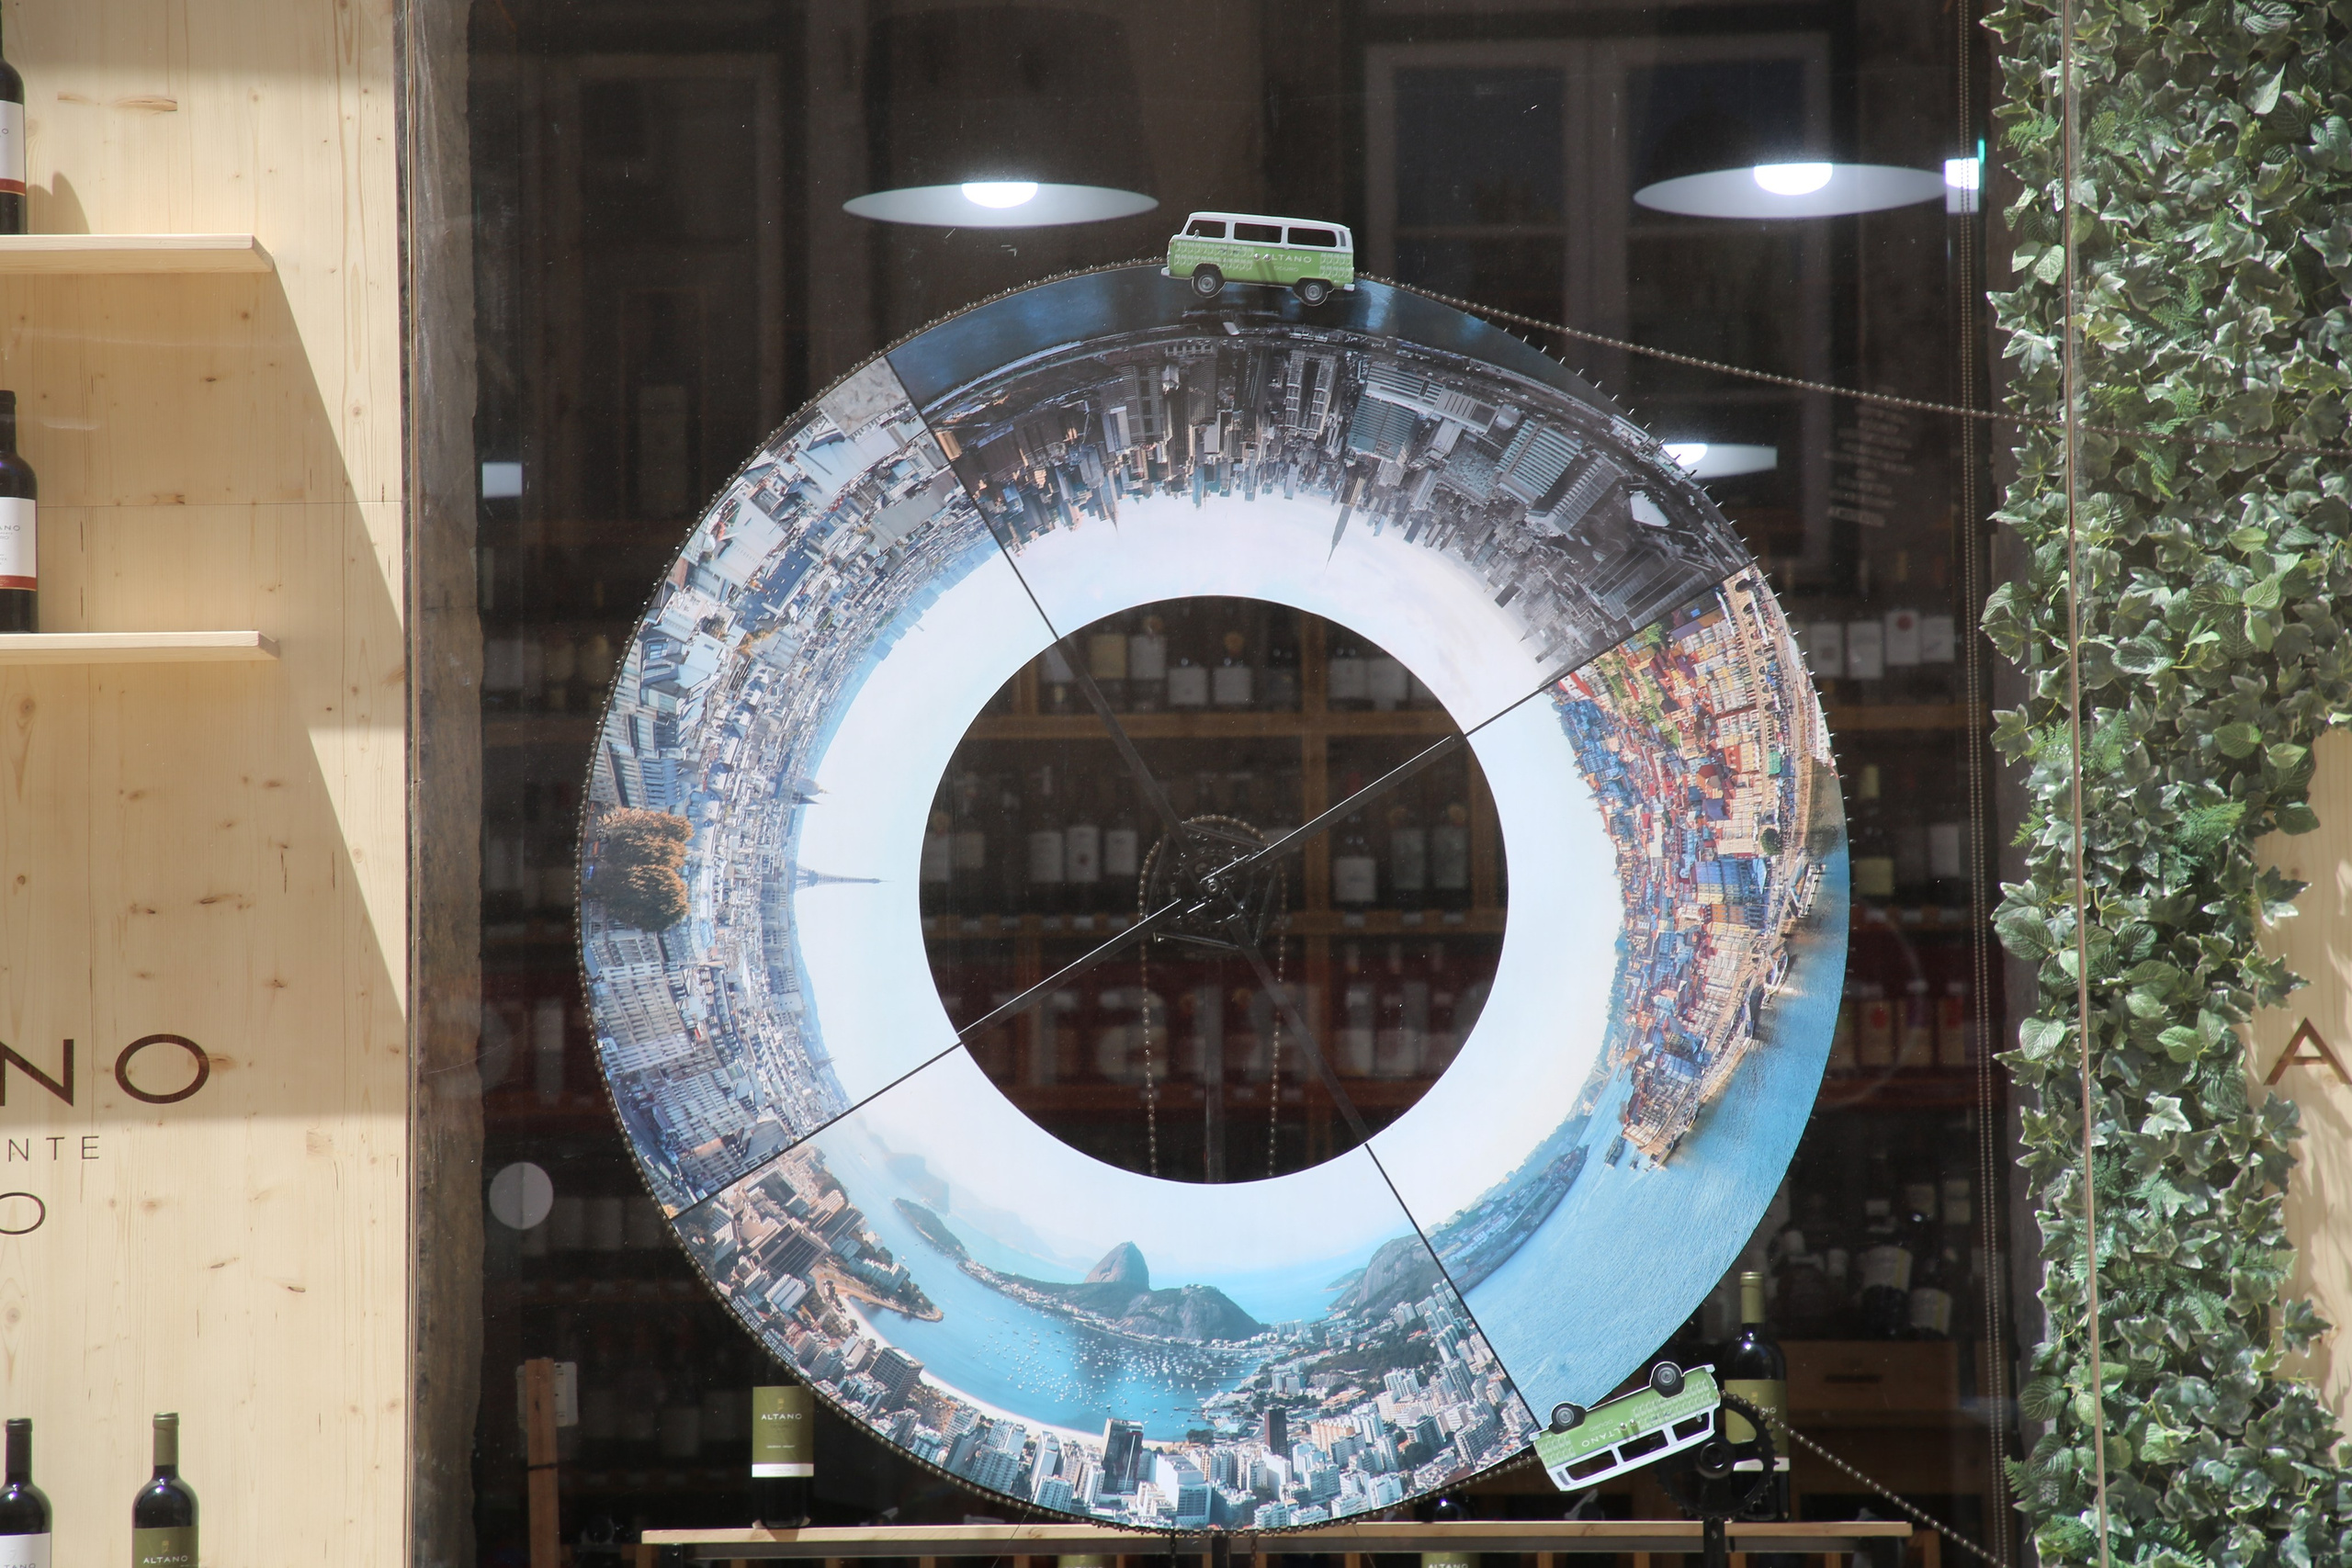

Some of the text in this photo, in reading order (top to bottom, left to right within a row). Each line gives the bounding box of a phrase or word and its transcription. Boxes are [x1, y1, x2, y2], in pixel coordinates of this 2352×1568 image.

[0, 1033, 210, 1107] NO
[8, 1135, 99, 1162] NTE
[1581, 1422, 1628, 1448] LTANO
[143, 1554, 188, 1564] ALTANO
